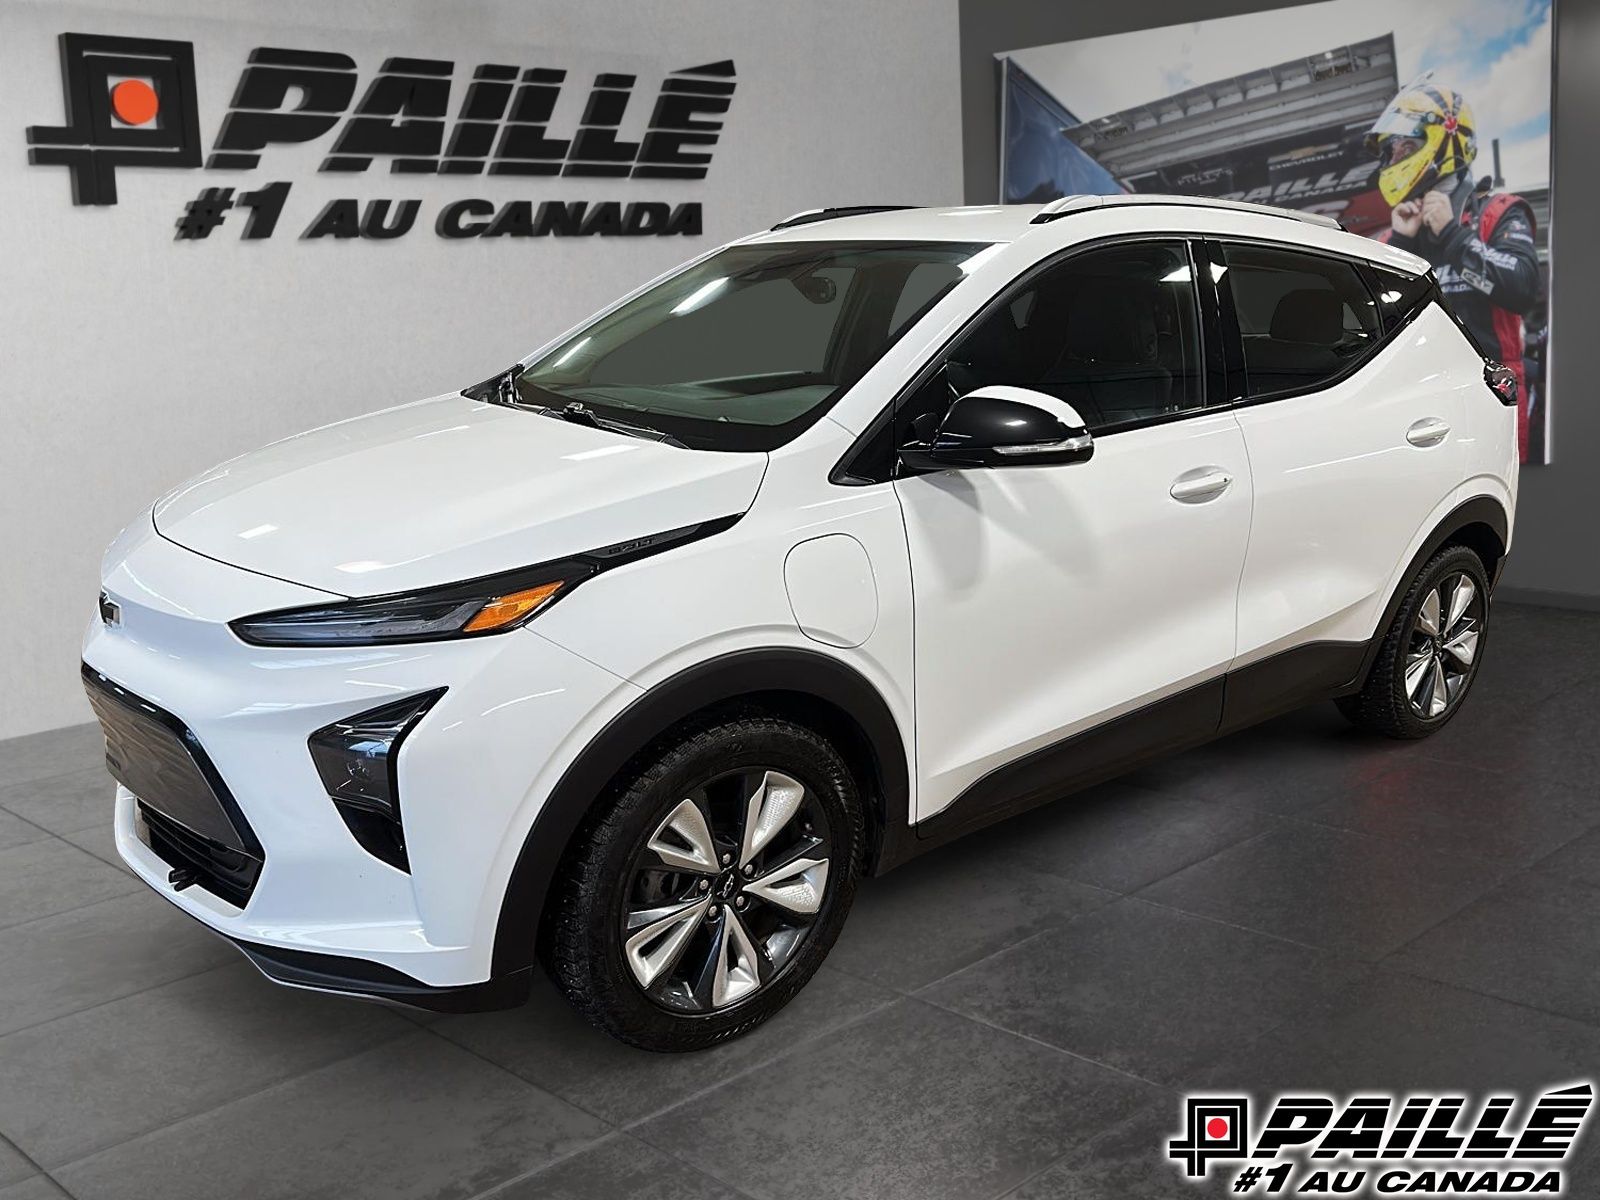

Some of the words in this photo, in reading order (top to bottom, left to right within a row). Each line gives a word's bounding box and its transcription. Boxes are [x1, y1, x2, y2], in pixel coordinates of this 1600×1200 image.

[205, 47, 737, 180] PAILLÉ
[1269, 150, 1344, 171] CHEVROLET
[174, 181, 293, 240] #1
[299, 198, 422, 240] AU
[435, 199, 704, 240] CANADA
[1274, 180, 1368, 203] CANADA
